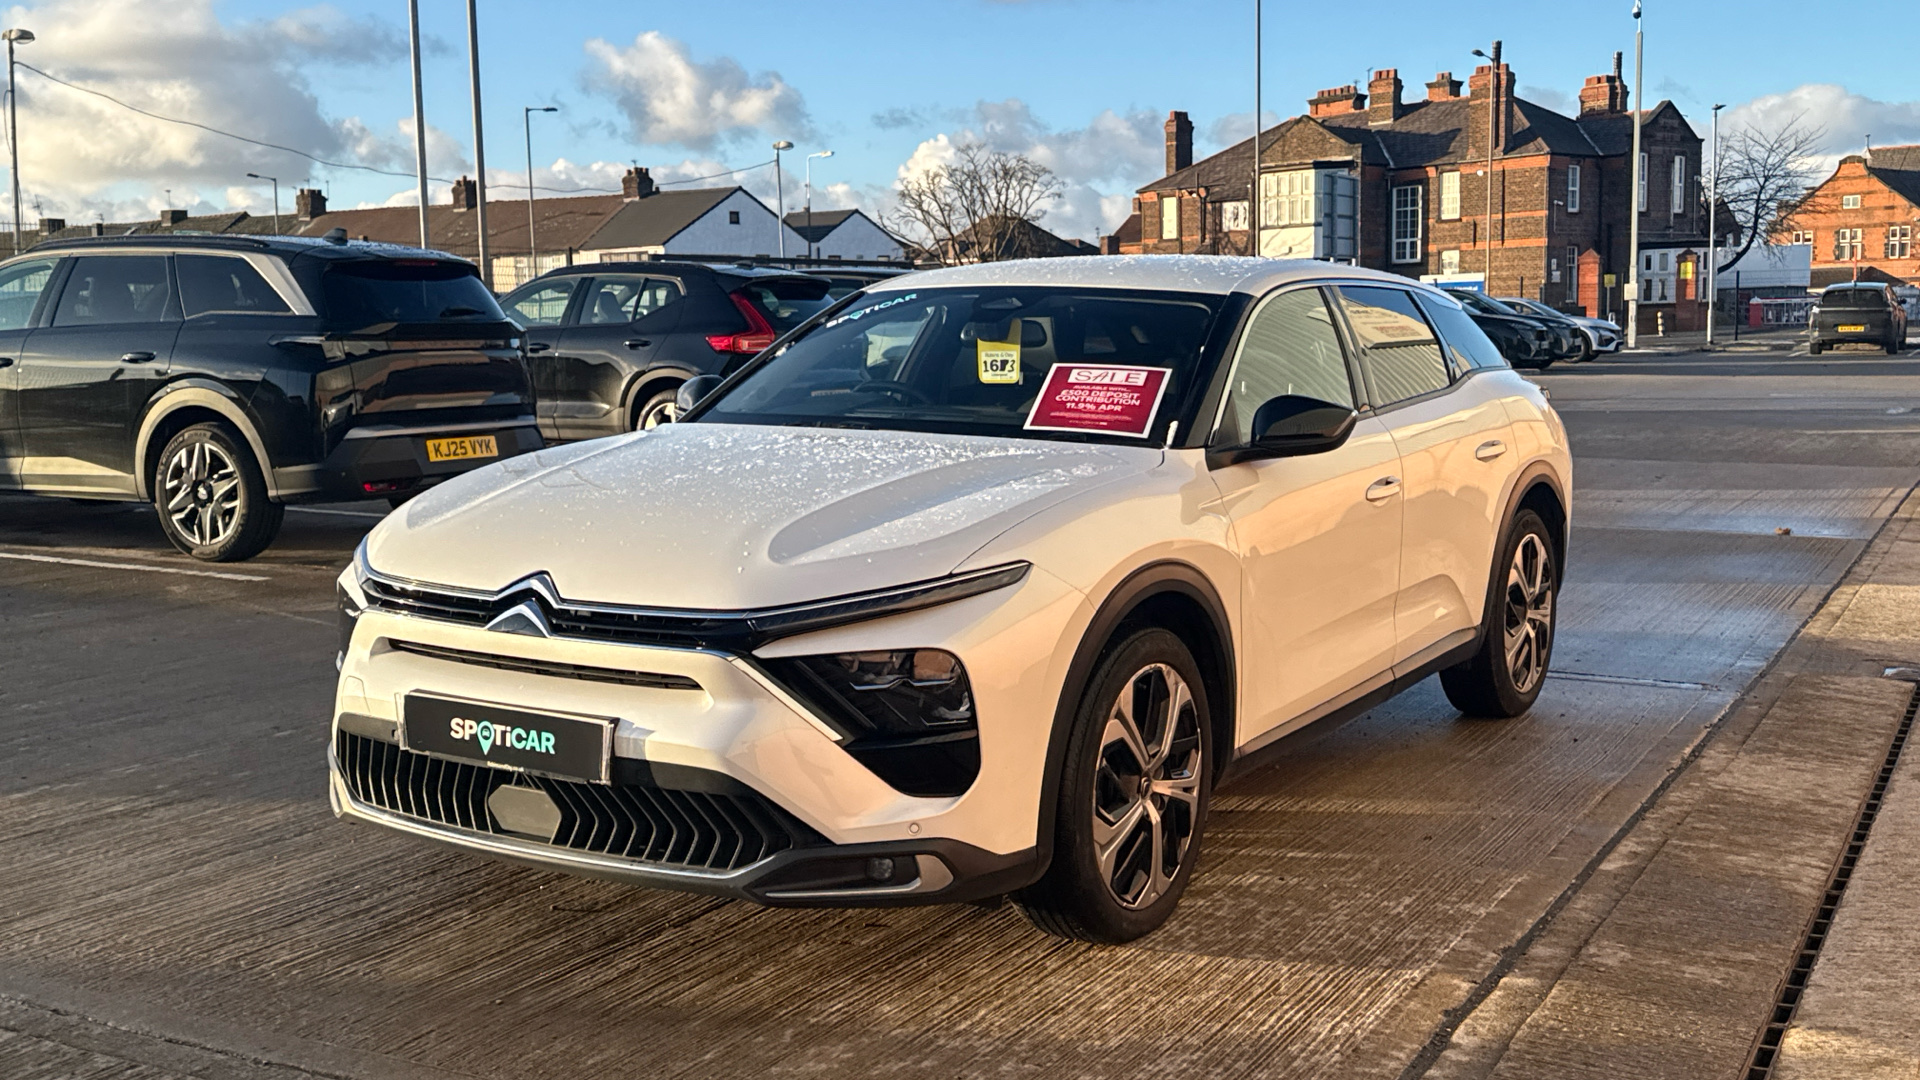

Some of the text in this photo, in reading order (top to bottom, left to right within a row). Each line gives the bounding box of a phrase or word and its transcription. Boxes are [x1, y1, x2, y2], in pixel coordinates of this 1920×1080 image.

[1075, 370, 1142, 384] SALE
[1060, 389, 1140, 400] £500 DEPOSIT
[1055, 395, 1141, 406] CONTRIBUTION
[1065, 402, 1096, 411] 11.9%
[433, 439, 493, 458] KJ25 VYK
